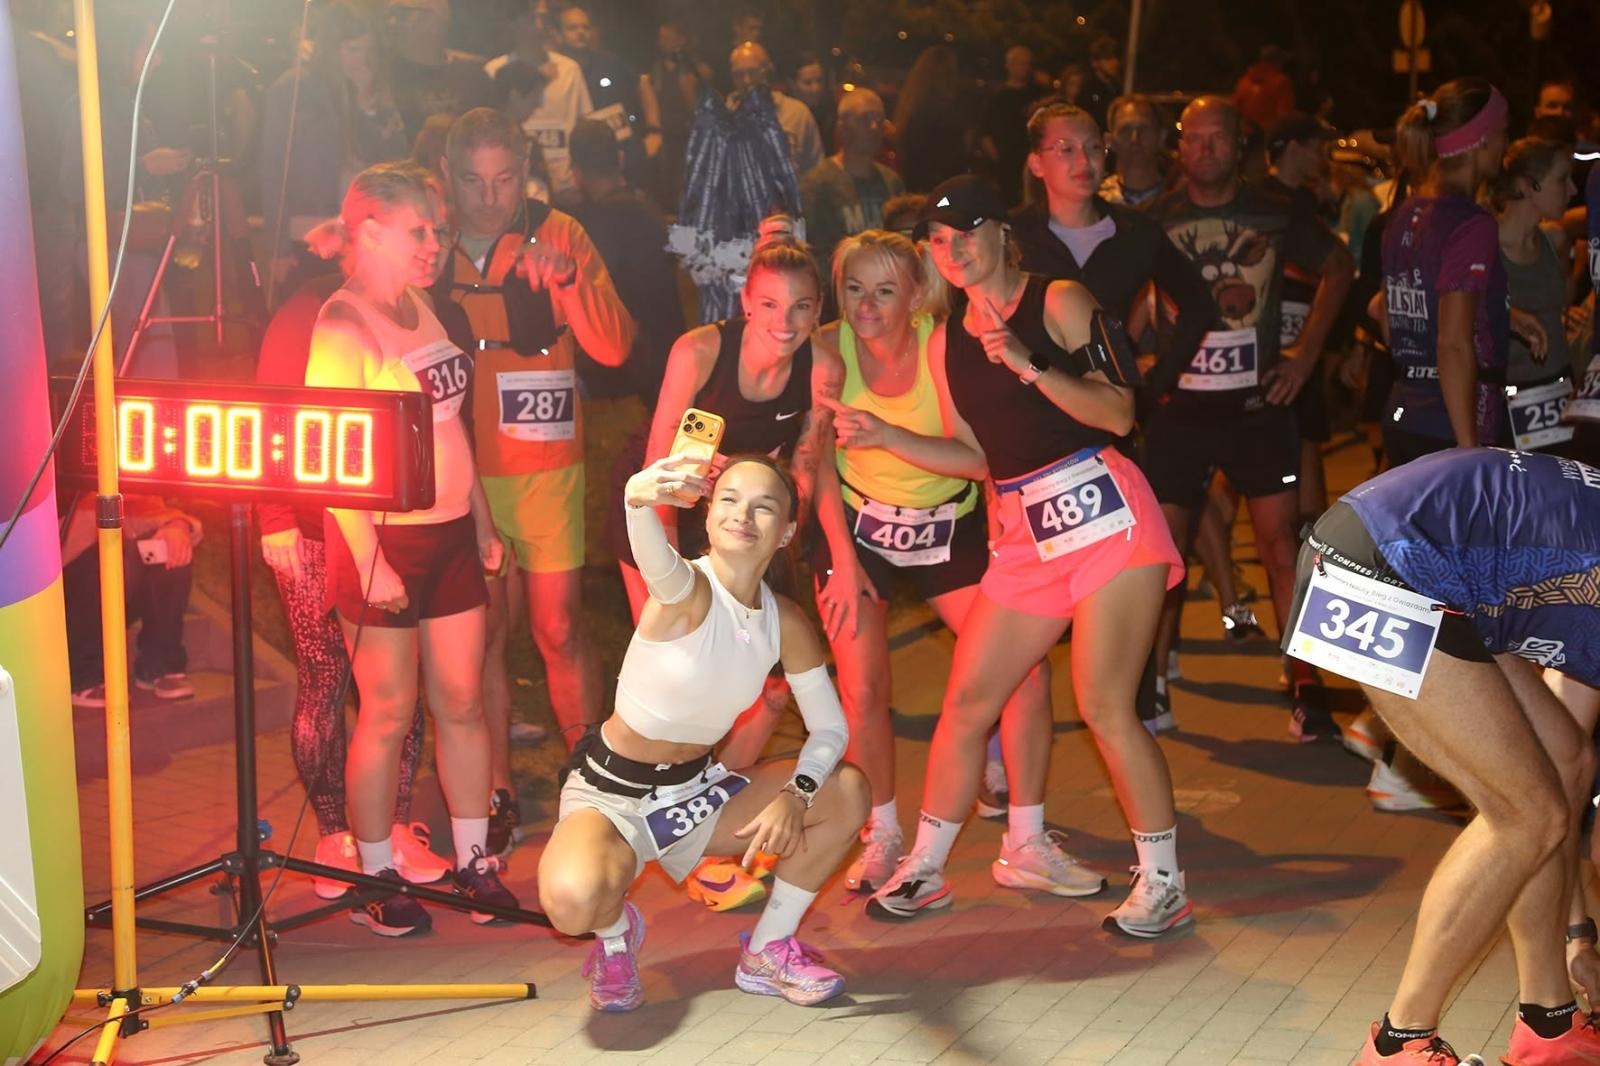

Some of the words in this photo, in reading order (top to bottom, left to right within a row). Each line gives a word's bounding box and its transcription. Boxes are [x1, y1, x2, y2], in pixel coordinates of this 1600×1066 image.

[428, 358, 467, 399] 316
[1191, 347, 1243, 373] 461
[516, 391, 567, 421] 287
[1041, 483, 1103, 532] 489
[870, 523, 936, 550] 404
[1320, 599, 1411, 659] 345
[665, 785, 730, 837] 381
